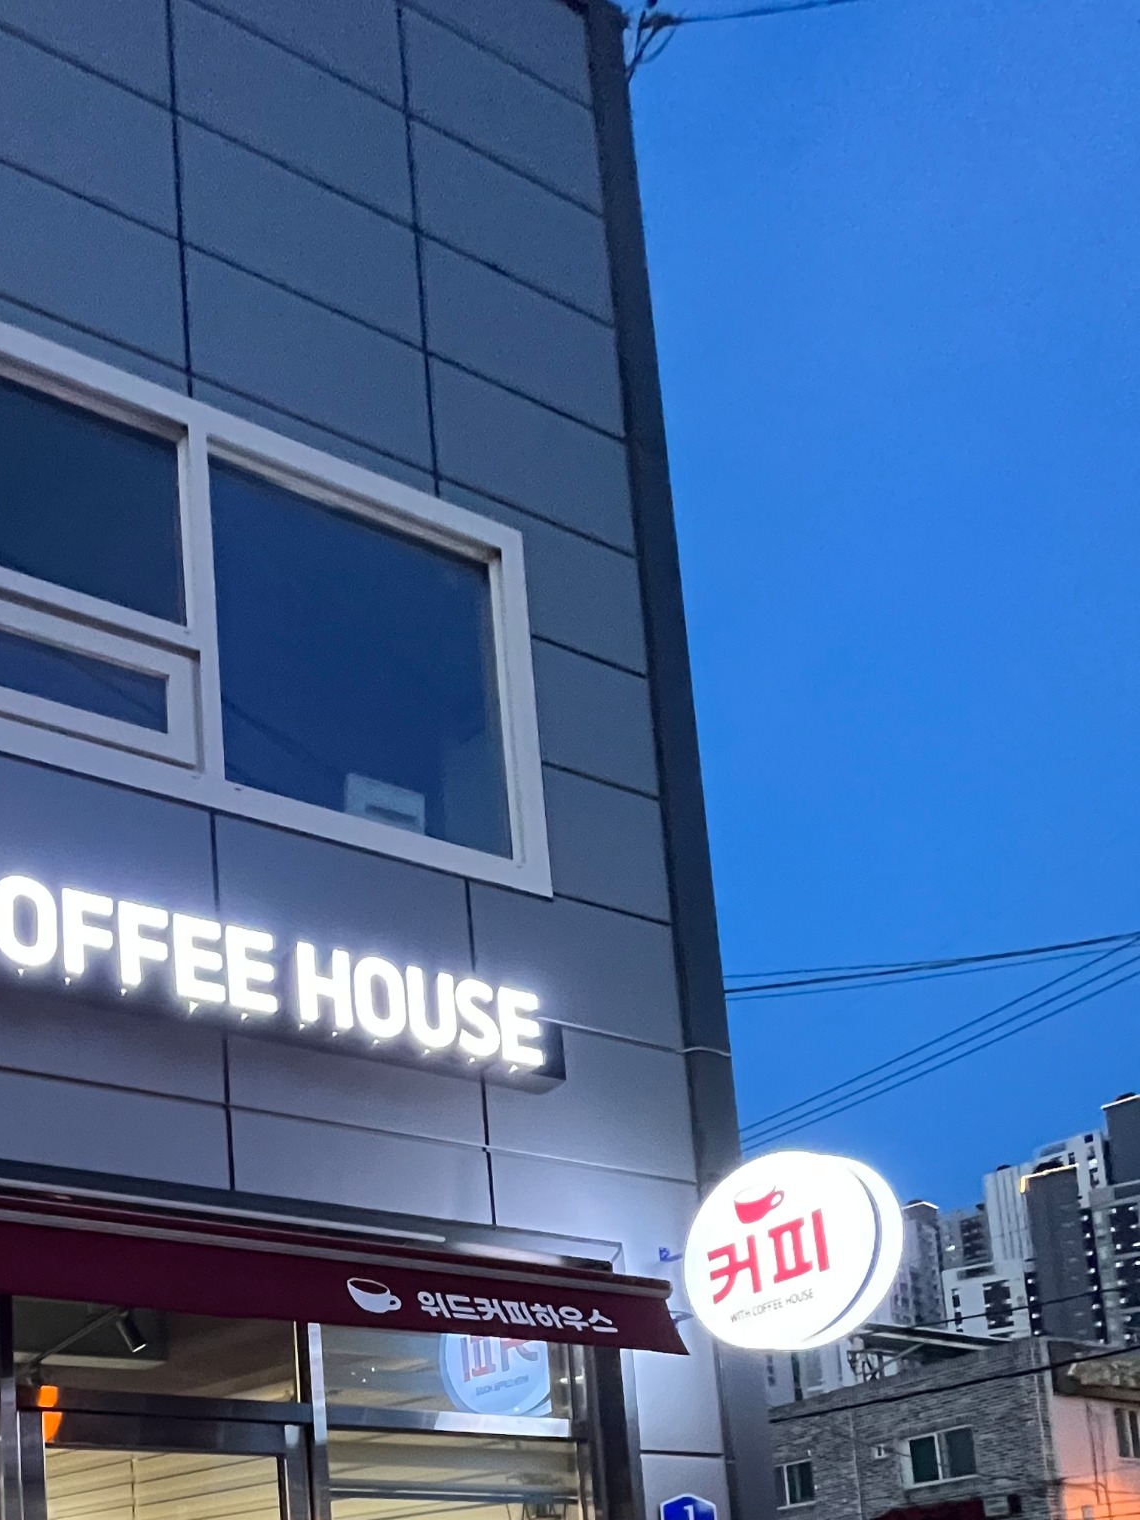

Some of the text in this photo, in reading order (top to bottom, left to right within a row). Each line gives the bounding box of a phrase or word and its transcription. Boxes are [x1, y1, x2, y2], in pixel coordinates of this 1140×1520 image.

[295, 941, 546, 1067] HOUSE
[707, 1208, 830, 1305] 커피
[417, 1290, 618, 1333] 위드커피하우스
[785, 1288, 814, 1304] HOUSE
